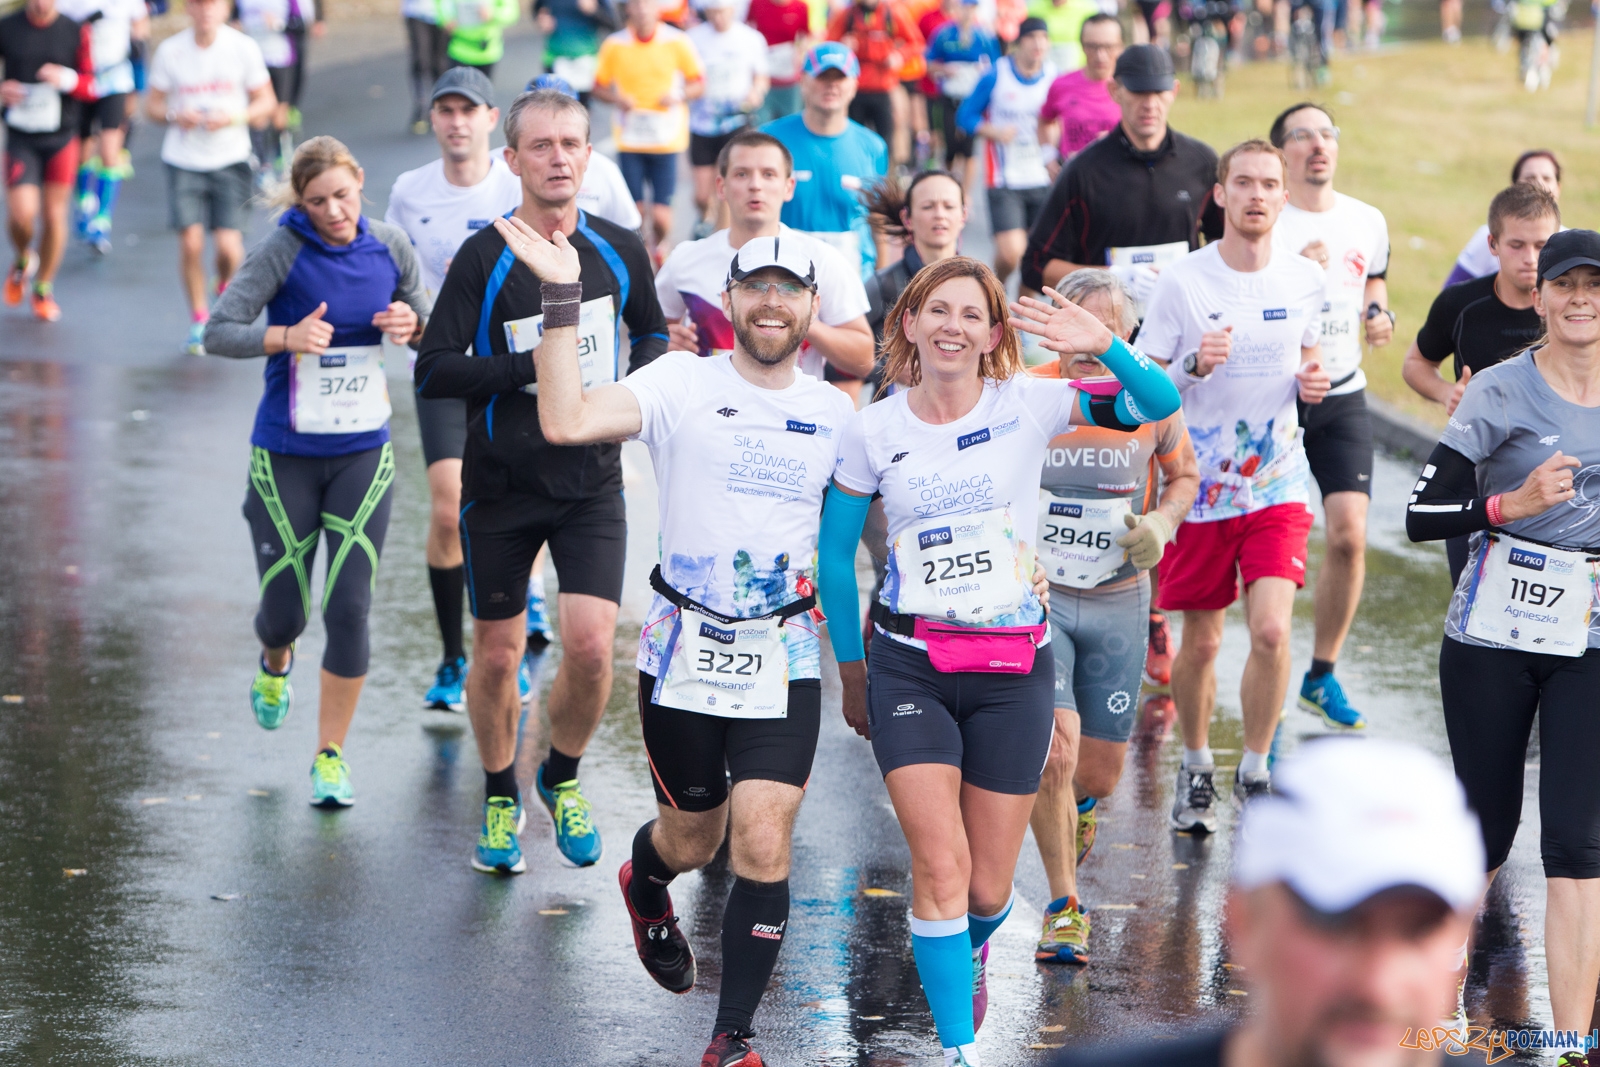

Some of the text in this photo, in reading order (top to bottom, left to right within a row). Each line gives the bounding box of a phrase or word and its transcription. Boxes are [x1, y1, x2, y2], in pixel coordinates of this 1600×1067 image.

[579, 334, 598, 357] 31
[319, 375, 369, 396] 3747
[733, 434, 765, 451] SIŁA
[1538, 434, 1561, 446] 4F
[741, 450, 807, 474] ODWAGA
[1098, 447, 1130, 468] ON
[729, 462, 807, 488] SZYBKOŚĆ
[907, 472, 943, 491] SIŁA
[920, 473, 993, 502] ODWAGA
[913, 485, 994, 517] SZYBKOŚĆ
[1043, 524, 1112, 550] 2946
[1050, 547, 1101, 563] Eugeniusz
[922, 549, 993, 585] 2255
[939, 581, 982, 598] Monika
[1510, 577, 1565, 608] 1197
[688, 602, 731, 624] performance
[1503, 604, 1559, 625] Agnieszka
[696, 648, 763, 676] 3221
[697, 677, 757, 692] Aleksander
